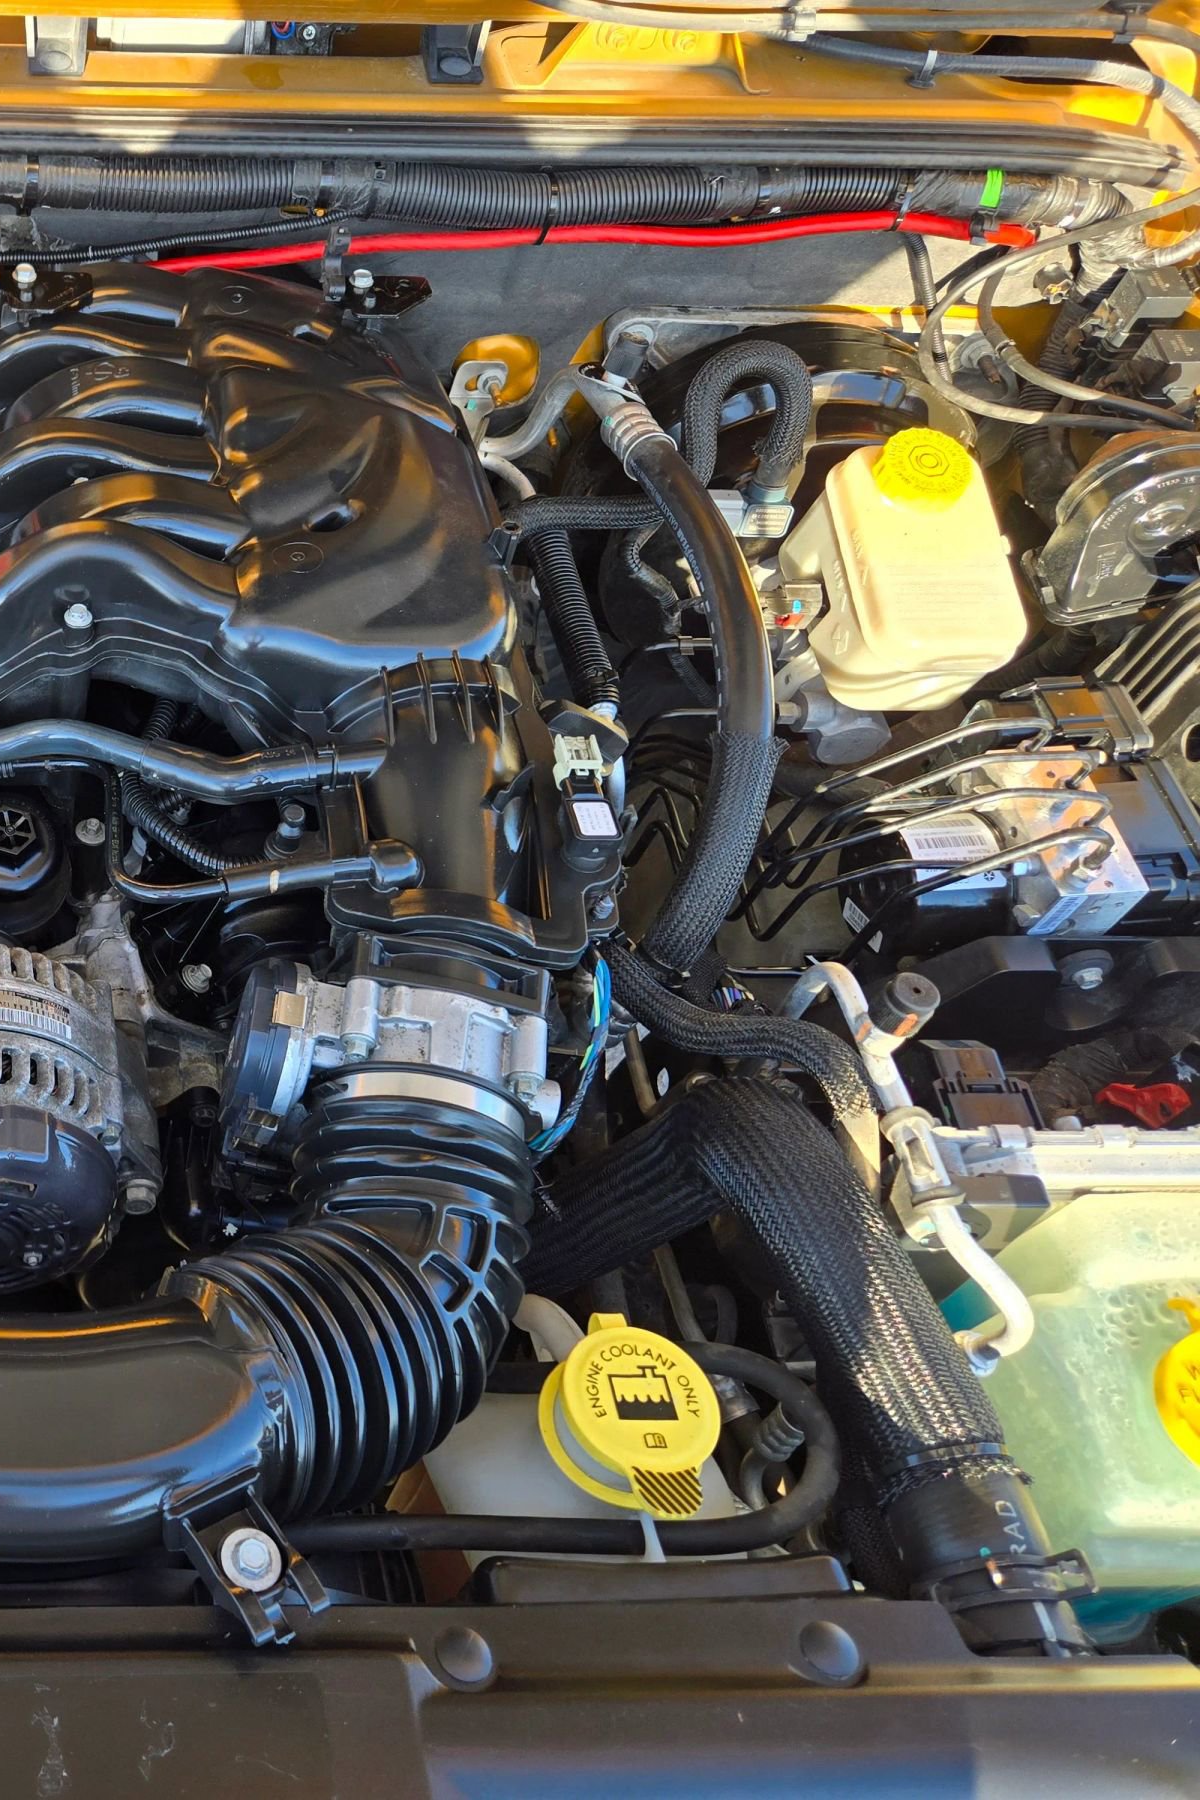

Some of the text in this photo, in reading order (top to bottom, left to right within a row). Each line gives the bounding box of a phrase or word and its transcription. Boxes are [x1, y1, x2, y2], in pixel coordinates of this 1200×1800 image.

[586, 1344, 700, 1418] ENGINE COOLANT ONLY
